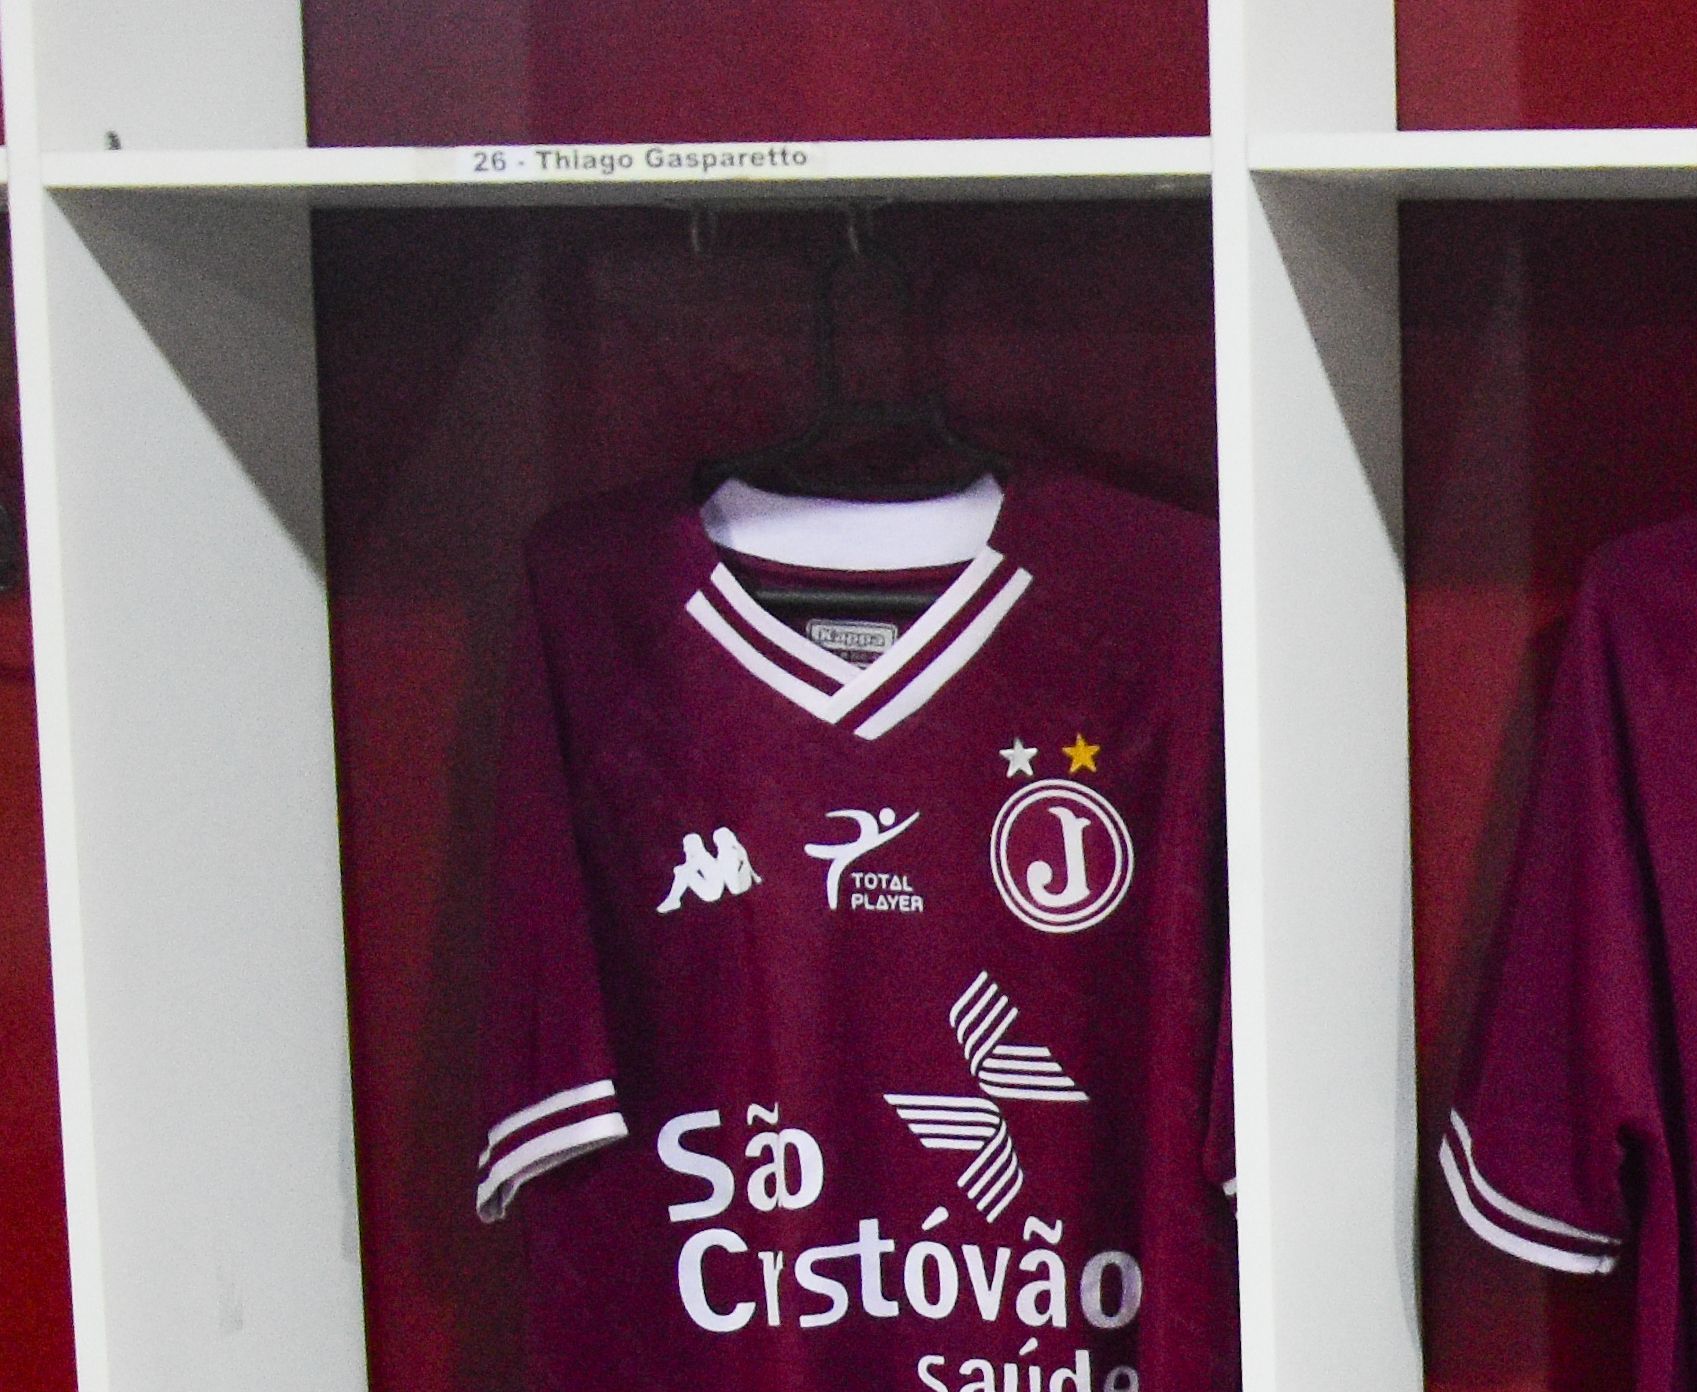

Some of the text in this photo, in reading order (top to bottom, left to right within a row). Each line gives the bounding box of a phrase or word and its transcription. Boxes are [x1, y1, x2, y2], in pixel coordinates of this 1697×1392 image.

[473, 151, 507, 172] 26
[535, 150, 634, 175] Thiago
[645, 146, 809, 174] Gasparetto
[1026, 805, 1091, 907] J
[851, 872, 914, 893] TOTAL
[851, 893, 924, 912] PLAYER
[657, 1103, 824, 1222] São
